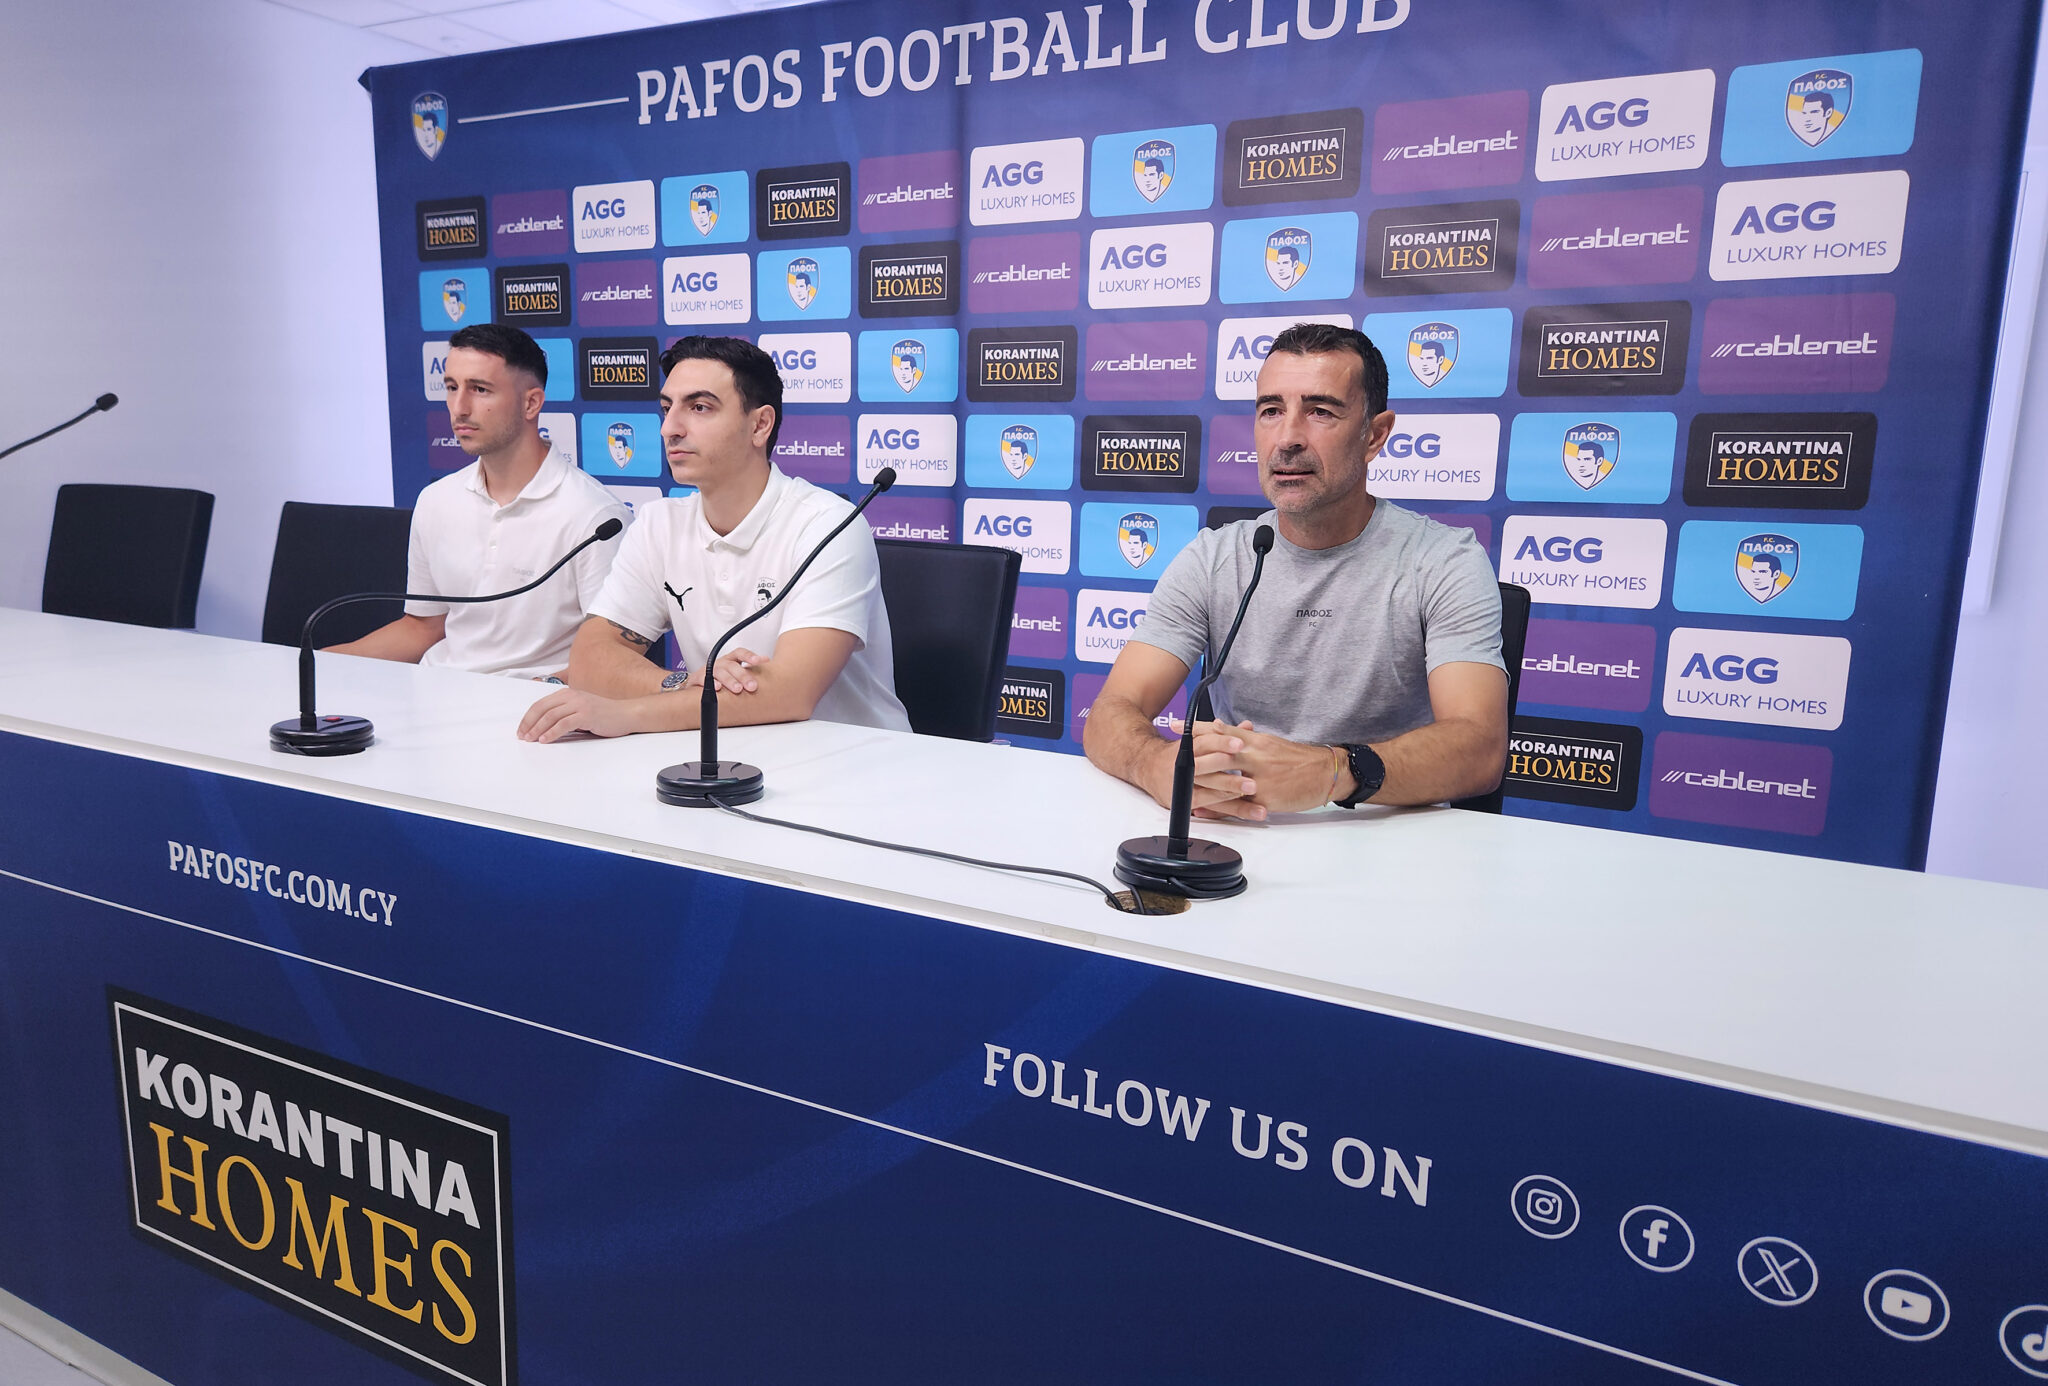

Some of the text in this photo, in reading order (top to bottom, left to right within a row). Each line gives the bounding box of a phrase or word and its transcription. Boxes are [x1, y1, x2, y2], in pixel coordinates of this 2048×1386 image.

[638, 49, 801, 125] PAFOS
[820, 4, 1167, 103] FOOTBALL
[1794, 78, 1847, 93] ΠΑΦΟΣ
[1554, 97, 1649, 135] AGG
[1137, 148, 1172, 159] ΠΑΦΟΣ
[1247, 137, 1339, 158] KORANTINA
[1403, 130, 1518, 160] cablenet
[1551, 134, 1695, 162] LUXURY HOMES
[982, 160, 1043, 188] AGG
[1247, 153, 1337, 181] HOMES
[771, 185, 836, 201] KORANTINA
[876, 182, 953, 204] cablenet
[981, 192, 1075, 210] LUXURY HOMES
[582, 199, 625, 220] AGG
[773, 199, 835, 221] HOMES
[1730, 200, 1836, 236] AGG
[427, 215, 475, 229] KORANTINA
[507, 215, 564, 233] cablenet
[429, 227, 476, 245] HOMES
[582, 225, 649, 239] LUXURY HOMES
[1270, 235, 1308, 246] ΠΑΦΟΣ
[1389, 228, 1491, 247] KORANTINA
[1562, 223, 1689, 251] cablenet
[1100, 243, 1166, 270] AGG
[1389, 245, 1489, 271] HOMES
[1727, 241, 1886, 264] LUXURY HOMES
[875, 263, 943, 277] KORANTINA
[988, 262, 1071, 283] cablenet
[506, 282, 557, 293] KORANTINA
[671, 272, 717, 293] AGG
[876, 277, 942, 297] HOMES
[1099, 276, 1201, 292] LUXURY HOMES
[508, 293, 557, 311] HOMES
[592, 284, 652, 301] cablenet
[671, 299, 743, 312] LUXURY HOMES
[1413, 330, 1455, 341] ΠΑΦΟΣ
[1547, 328, 1660, 346] KORANTINA
[1735, 332, 1877, 357] cablenet
[984, 348, 1059, 360] KORANTINA
[1227, 335, 1274, 360] AG
[591, 355, 646, 366] KORANTINA
[1107, 352, 1197, 371] cablenet
[1547, 346, 1657, 371] HOMES
[593, 367, 645, 383] HOMES
[986, 362, 1058, 381] HOMES
[808, 379, 843, 389] HOMES
[866, 428, 919, 450] AGG
[1101, 438, 1181, 450] KORANTINA
[1569, 431, 1615, 442] ΠΑΦΟΣ
[777, 440, 845, 457] cablenet
[1717, 441, 1843, 455] KORANTINA
[865, 458, 948, 471] LUXURY HOMES
[1102, 452, 1180, 471] HOMES
[1717, 458, 1839, 482] HOMES
[1367, 469, 1481, 483] UXURY HOMES
[876, 522, 949, 541] cablenet
[974, 515, 1032, 537] AGG
[1122, 519, 1155, 529] ΠΑΦΟΣ
[1022, 546, 1063, 560] HOMES
[1514, 535, 1603, 563] AGG
[1744, 542, 1794, 554] ΠΑΦΟΣ
[1511, 571, 1647, 591] LUXURY HOMES
[1011, 613, 1061, 632] lenet
[1296, 609, 1332, 618] ΠΑΦΟΣ
[1086, 636, 1127, 650] LUXUR
[1521, 653, 1640, 679] cablenet
[1680, 652, 1778, 684] AGG
[1001, 684, 1048, 698] ANTINA
[1677, 689, 1827, 715] LUXURY HOMES
[1509, 739, 1615, 761] KORANTINA
[1509, 754, 1612, 784] HOMES
[1684, 769, 1817, 799] cablenet
[168, 841, 397, 926] PAFOSFC.COM.CY
[983, 1042, 1432, 1207] FOLLOW US ON
[136, 1047, 480, 1229] KORANTINA
[148, 1121, 477, 1345] HOMES
